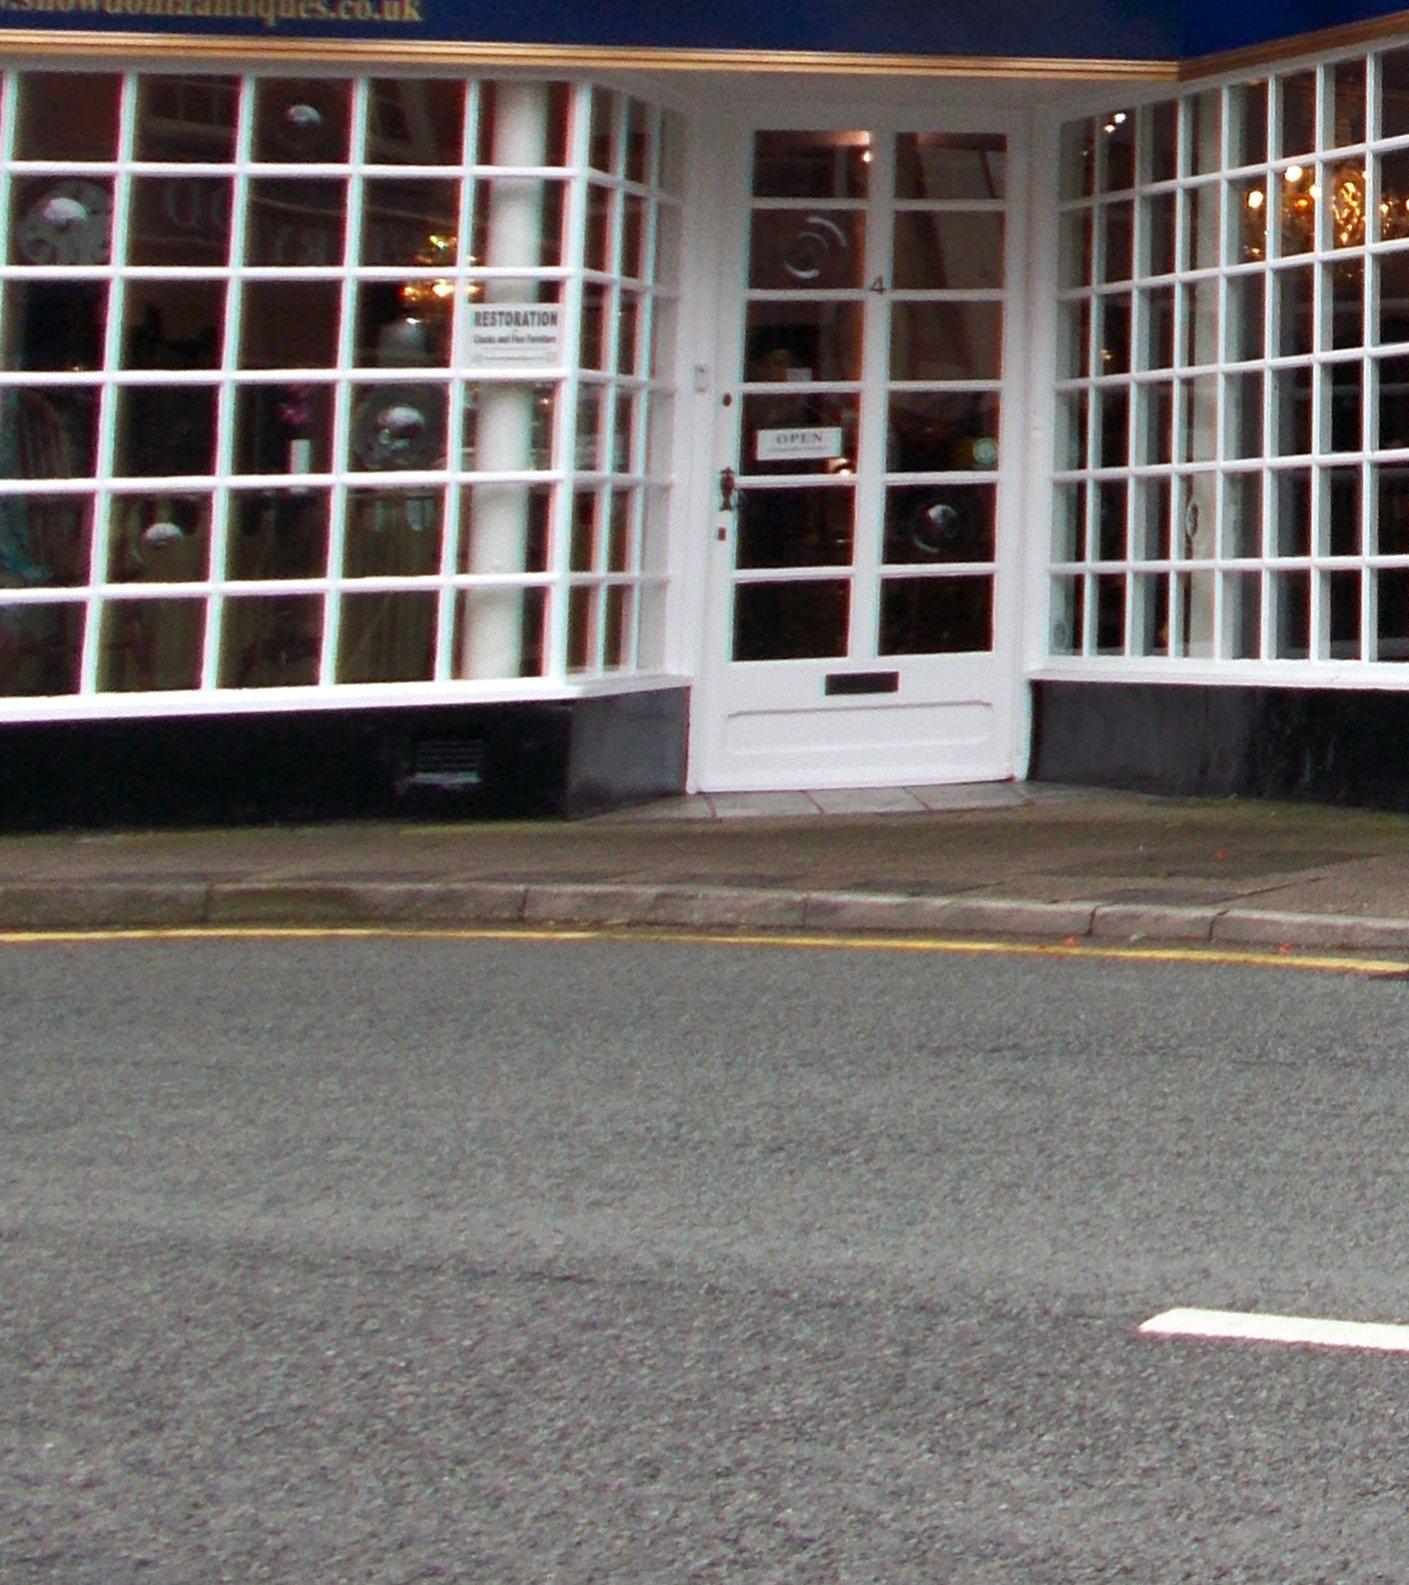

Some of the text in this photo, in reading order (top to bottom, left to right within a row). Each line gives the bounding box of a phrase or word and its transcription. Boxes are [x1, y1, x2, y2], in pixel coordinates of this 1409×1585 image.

[870, 276, 886, 296] 4
[474, 311, 558, 327] RESTORATION
[776, 433, 822, 445] OPEN
